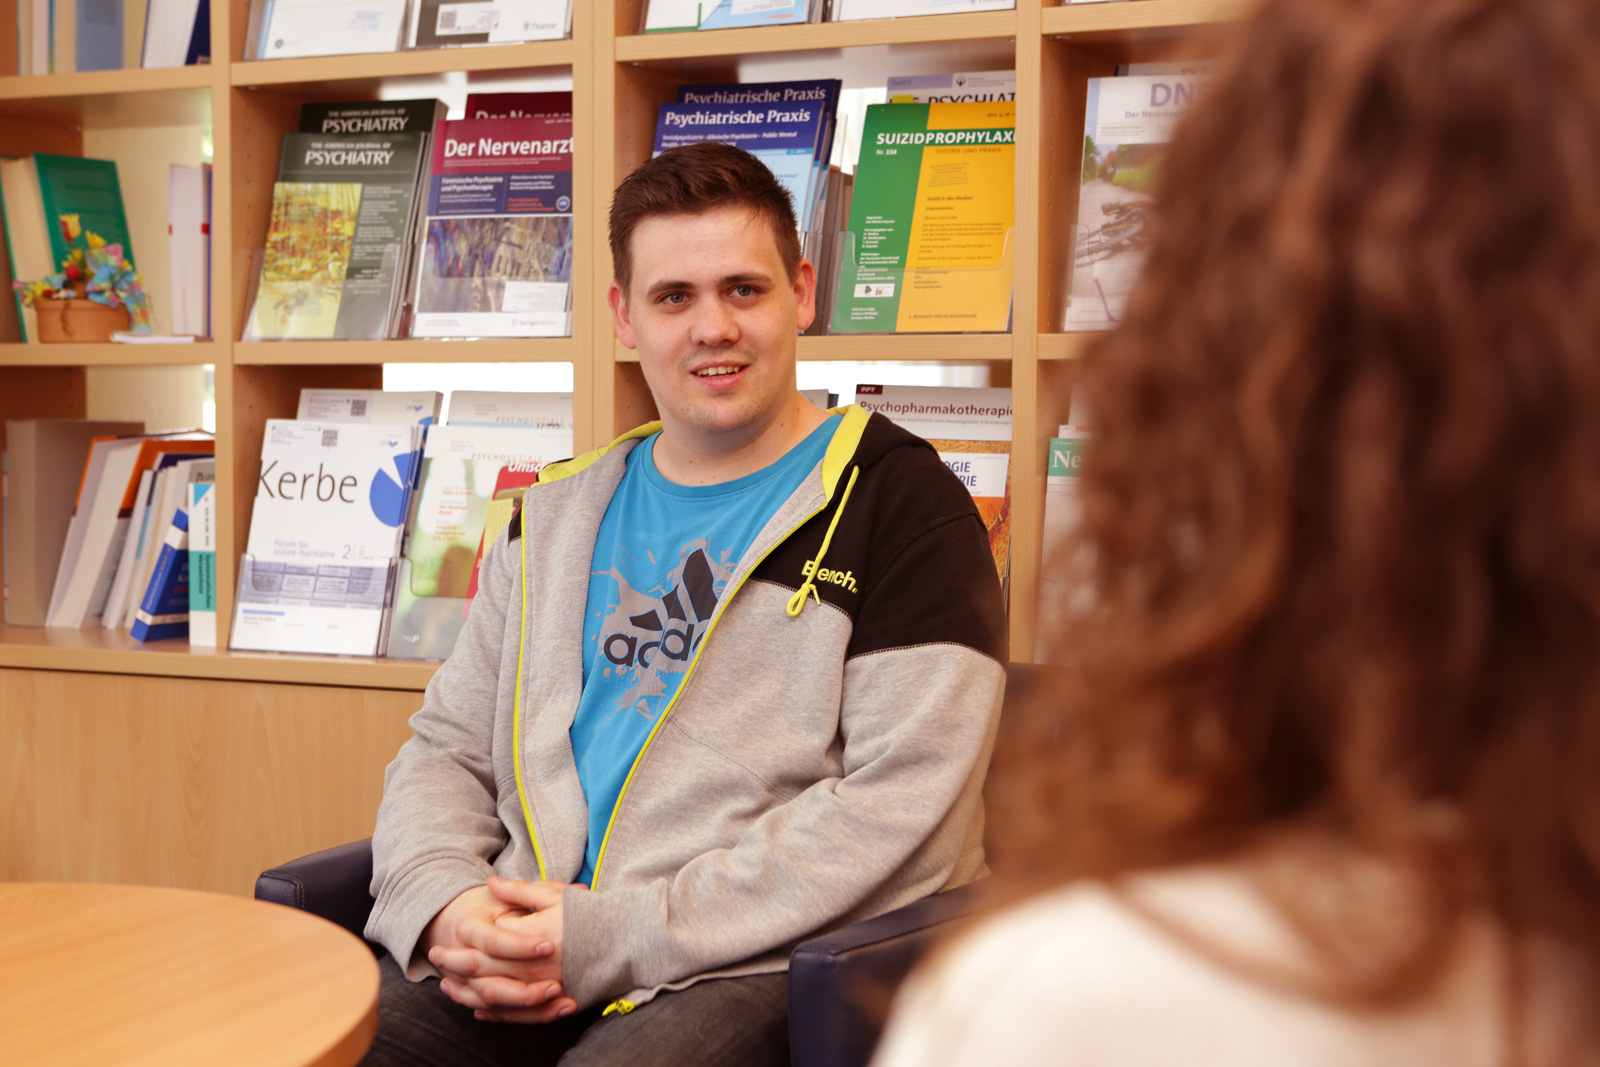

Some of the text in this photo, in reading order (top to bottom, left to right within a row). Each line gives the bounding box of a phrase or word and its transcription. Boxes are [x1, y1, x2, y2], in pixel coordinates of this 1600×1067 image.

[531, 22, 557, 30] Thieme
[783, 86, 826, 102] Praxis
[1150, 82, 1196, 108] DN
[322, 116, 409, 133] PSYCHIATRY
[665, 108, 811, 128] Psychiatrische Praxis
[876, 130, 1016, 145] SUIZIDPROPHYLAXI
[444, 137, 574, 158] Der Nervenarzt
[304, 149, 395, 166] PSYCHIATRY
[508, 460, 542, 474] Umsc
[944, 461, 971, 473] OGIE
[1052, 450, 1083, 469] Ne
[256, 460, 358, 503] Kerbe
[342, 544, 352, 559] 2
